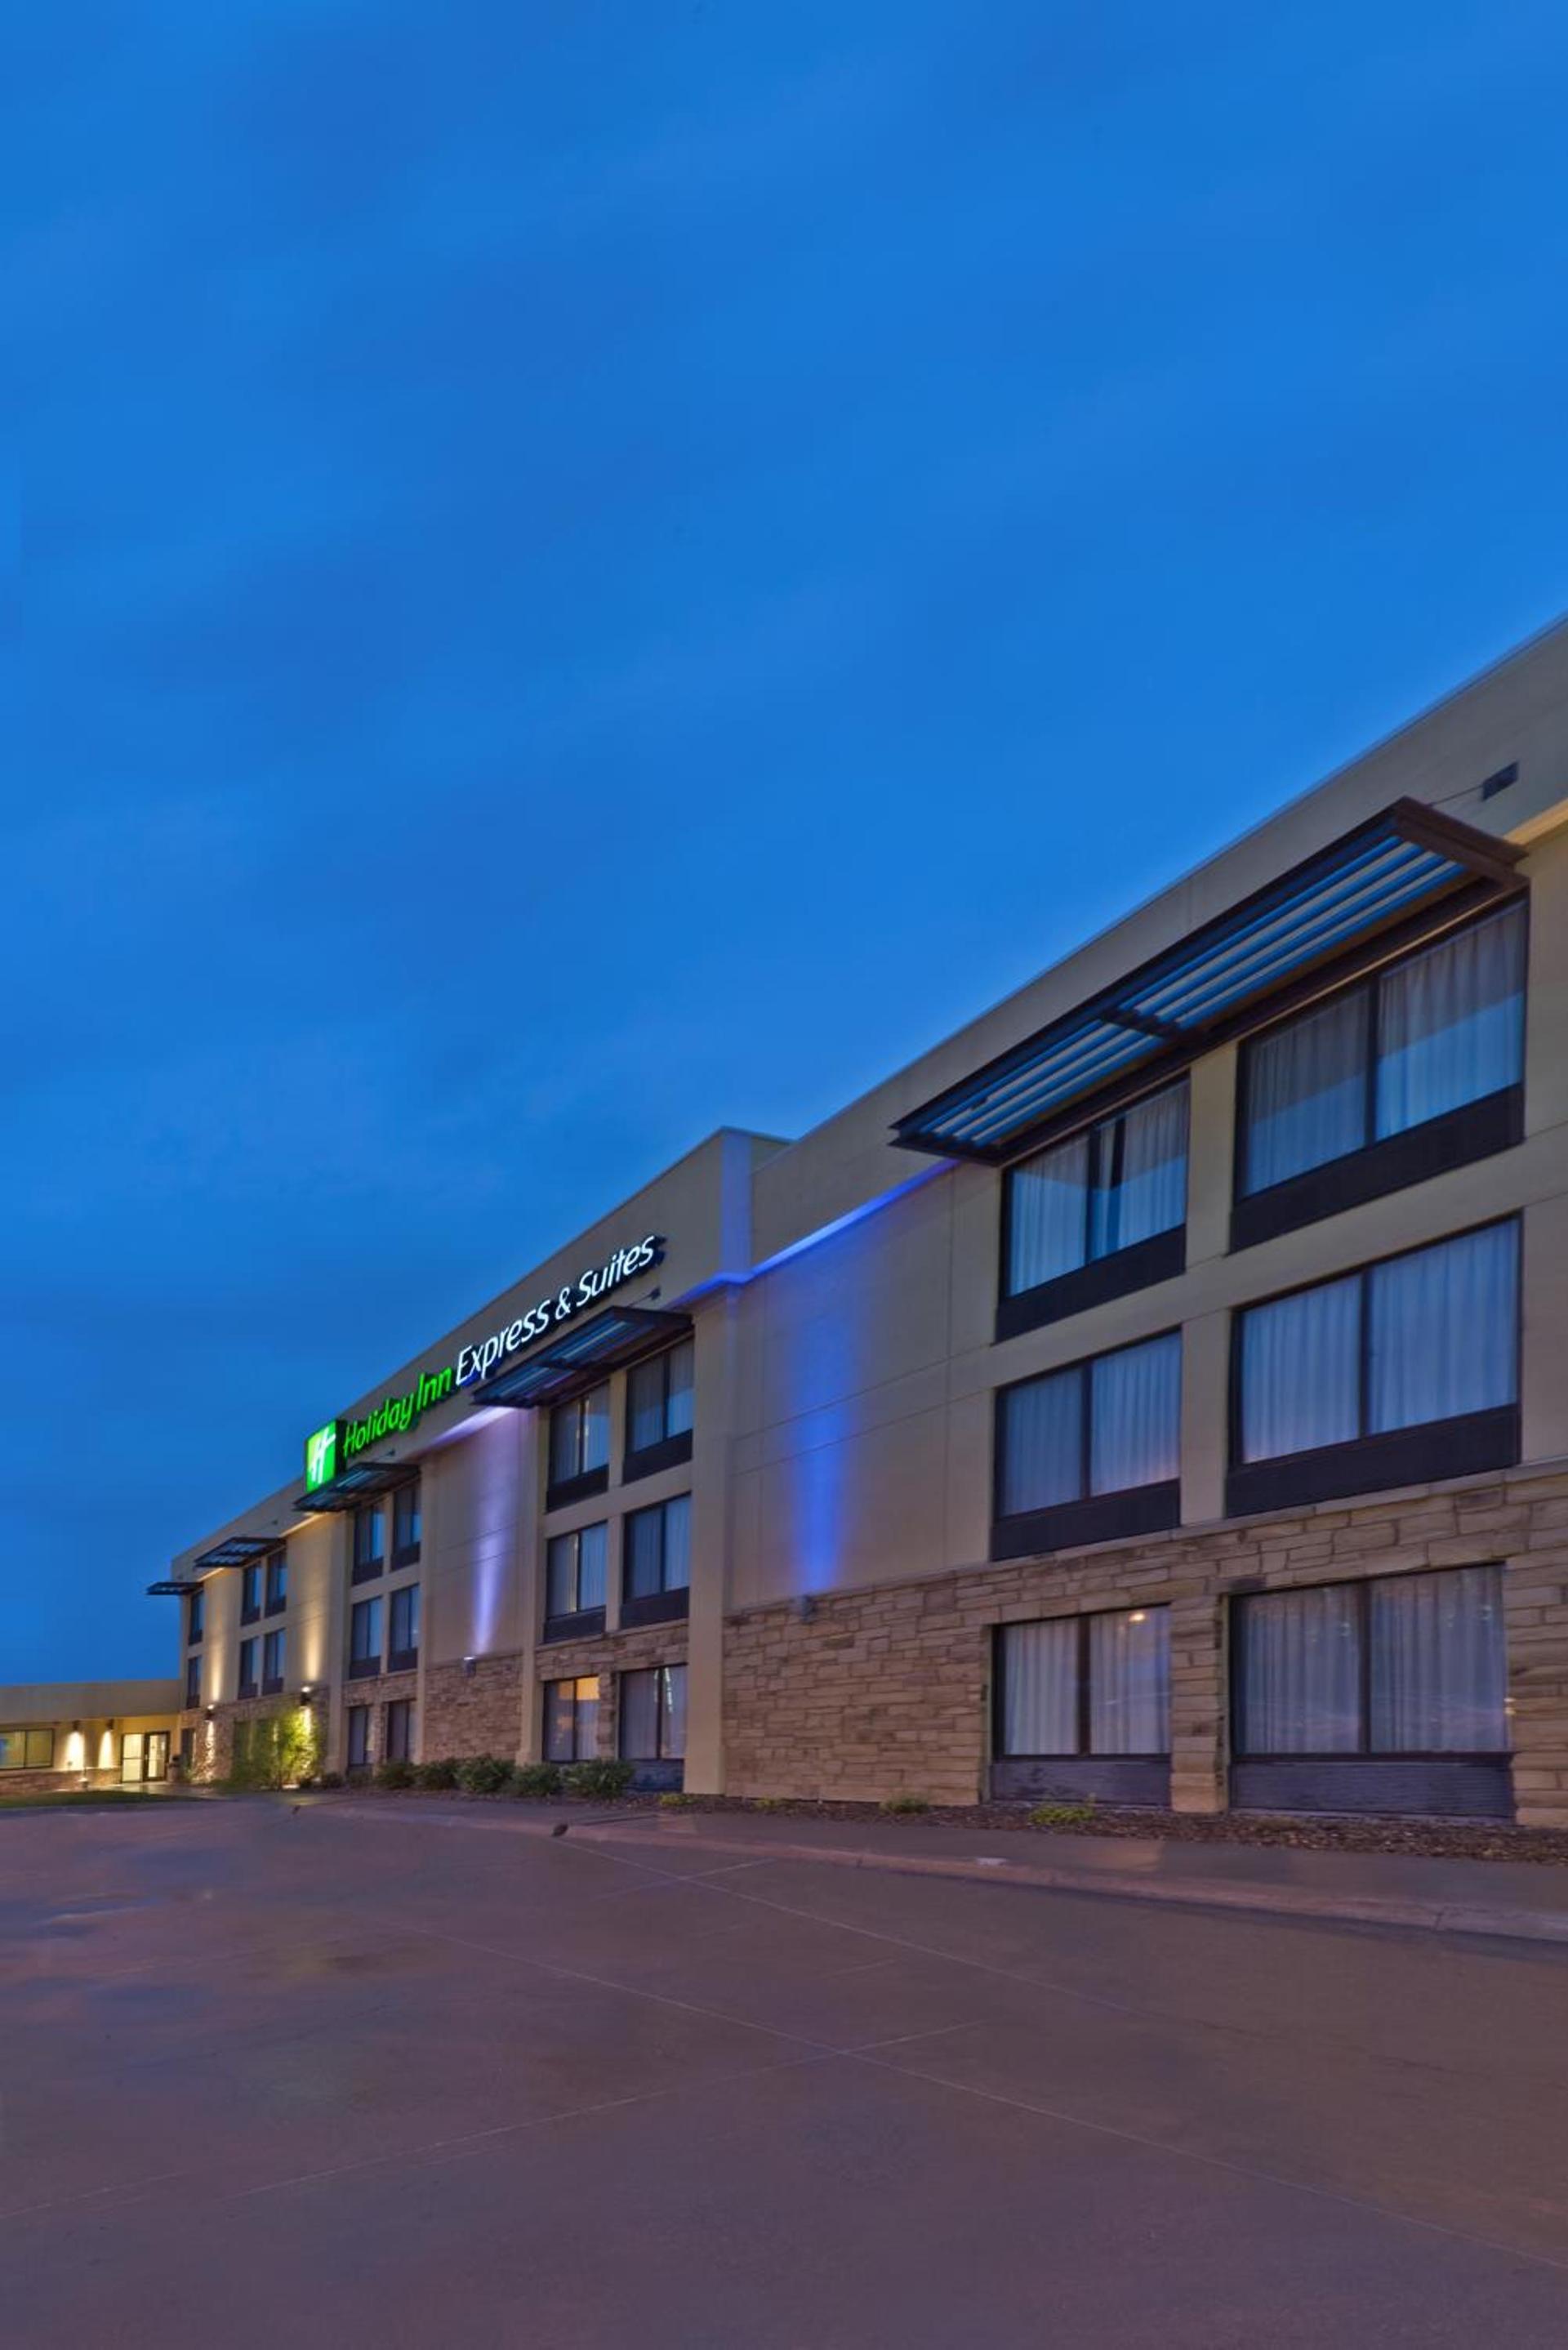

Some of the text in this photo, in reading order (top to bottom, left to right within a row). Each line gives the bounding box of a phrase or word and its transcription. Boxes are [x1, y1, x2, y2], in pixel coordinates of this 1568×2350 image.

[344, 1236, 655, 1458] Holiday Inn Express & Suites
